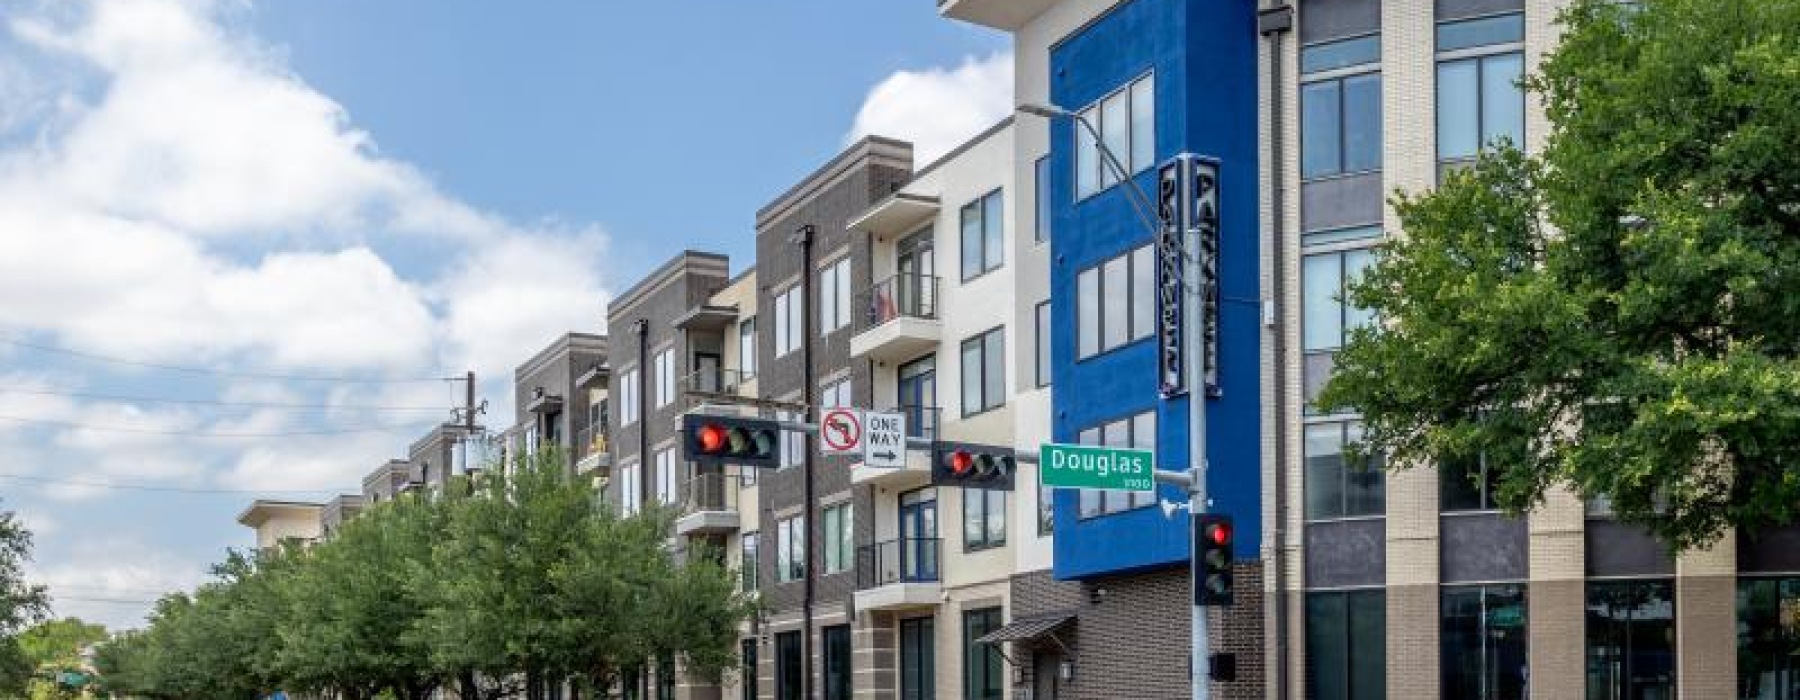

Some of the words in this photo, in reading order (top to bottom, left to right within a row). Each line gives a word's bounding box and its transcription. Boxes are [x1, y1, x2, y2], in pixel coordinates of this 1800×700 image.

[870, 416, 899, 431] ONE
[870, 432, 901, 445] WAY
[1052, 449, 1142, 477] Douglas
